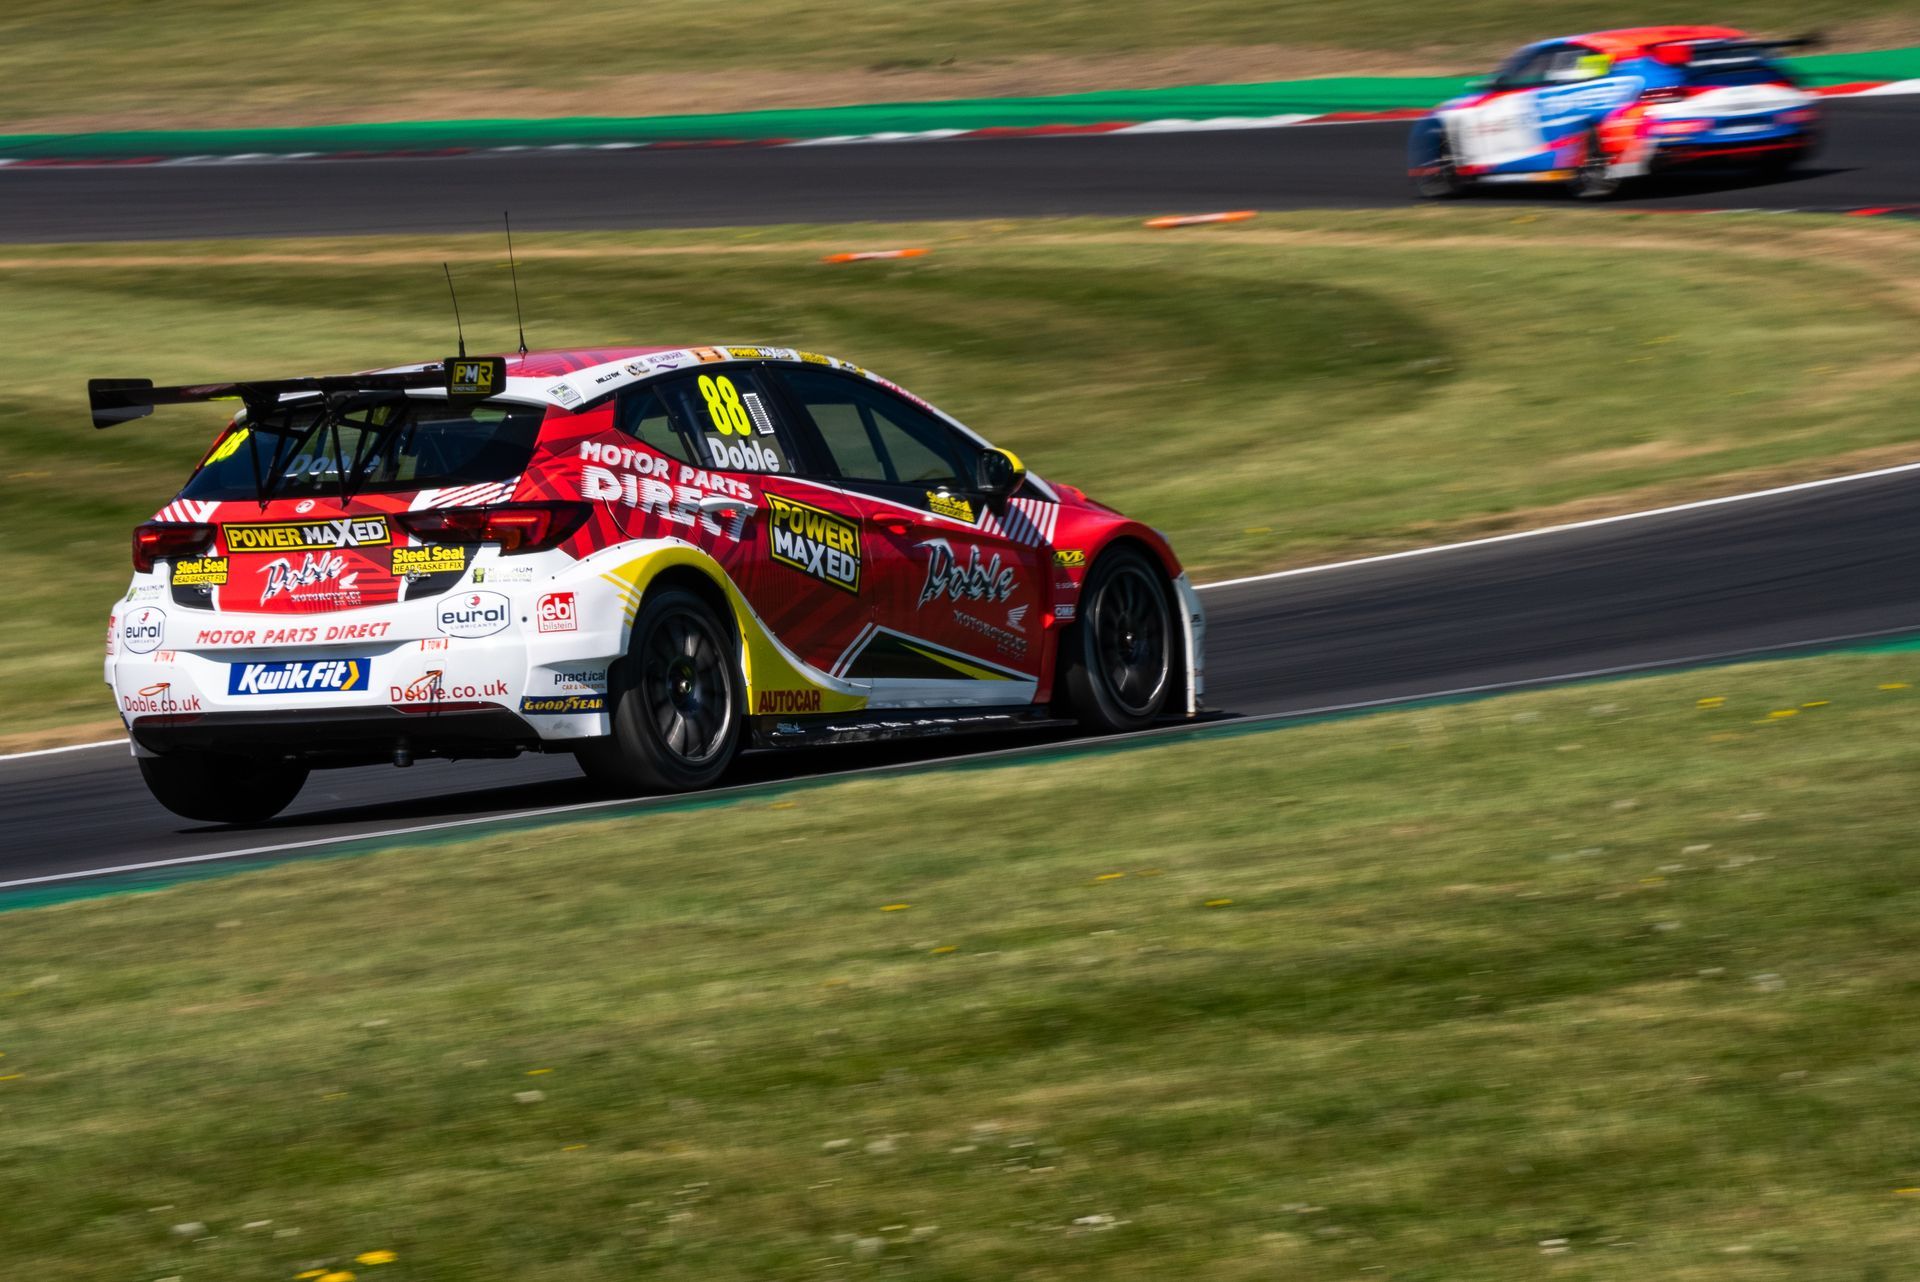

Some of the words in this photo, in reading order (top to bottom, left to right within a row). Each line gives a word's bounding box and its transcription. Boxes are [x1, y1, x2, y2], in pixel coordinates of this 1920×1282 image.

[455, 365, 491, 383] PMR
[698, 375, 751, 436] 88
[706, 437, 779, 473] Doble
[580, 440, 670, 480] MOTOR
[680, 465, 752, 499] PARTS
[581, 465, 757, 542] DIRECT
[229, 528, 303, 548] POWER
[304, 519, 384, 548] MAXED
[774, 501, 854, 554] POWER
[392, 548, 432, 563] Steel
[433, 546, 465, 561] Seal
[774, 526, 856, 584] MAXED
[176, 559, 203, 575] Steel
[203, 557, 229, 573] Seal
[394, 564, 415, 573] HEAD
[415, 563, 448, 572] GASKET
[449, 561, 463, 570] FIX
[912, 538, 1019, 611] Doble
[256, 551, 349, 607] Doble
[441, 605, 505, 624] eurol
[537, 595, 574, 620] febi
[126, 622, 161, 638] eurol
[196, 630, 256, 645] MOTOR
[263, 627, 318, 643] PARTS
[324, 621, 391, 641] DIRECT
[450, 622, 497, 630] LUBRICANTS
[543, 622, 573, 631] bilstein
[554, 669, 606, 685] practical
[390, 680, 508, 702] Doble.co.uk
[758, 690, 821, 712] AUTOCAR
[124, 695, 201, 713] Doble.co.uk
[524, 697, 603, 712] GOODYEAR
